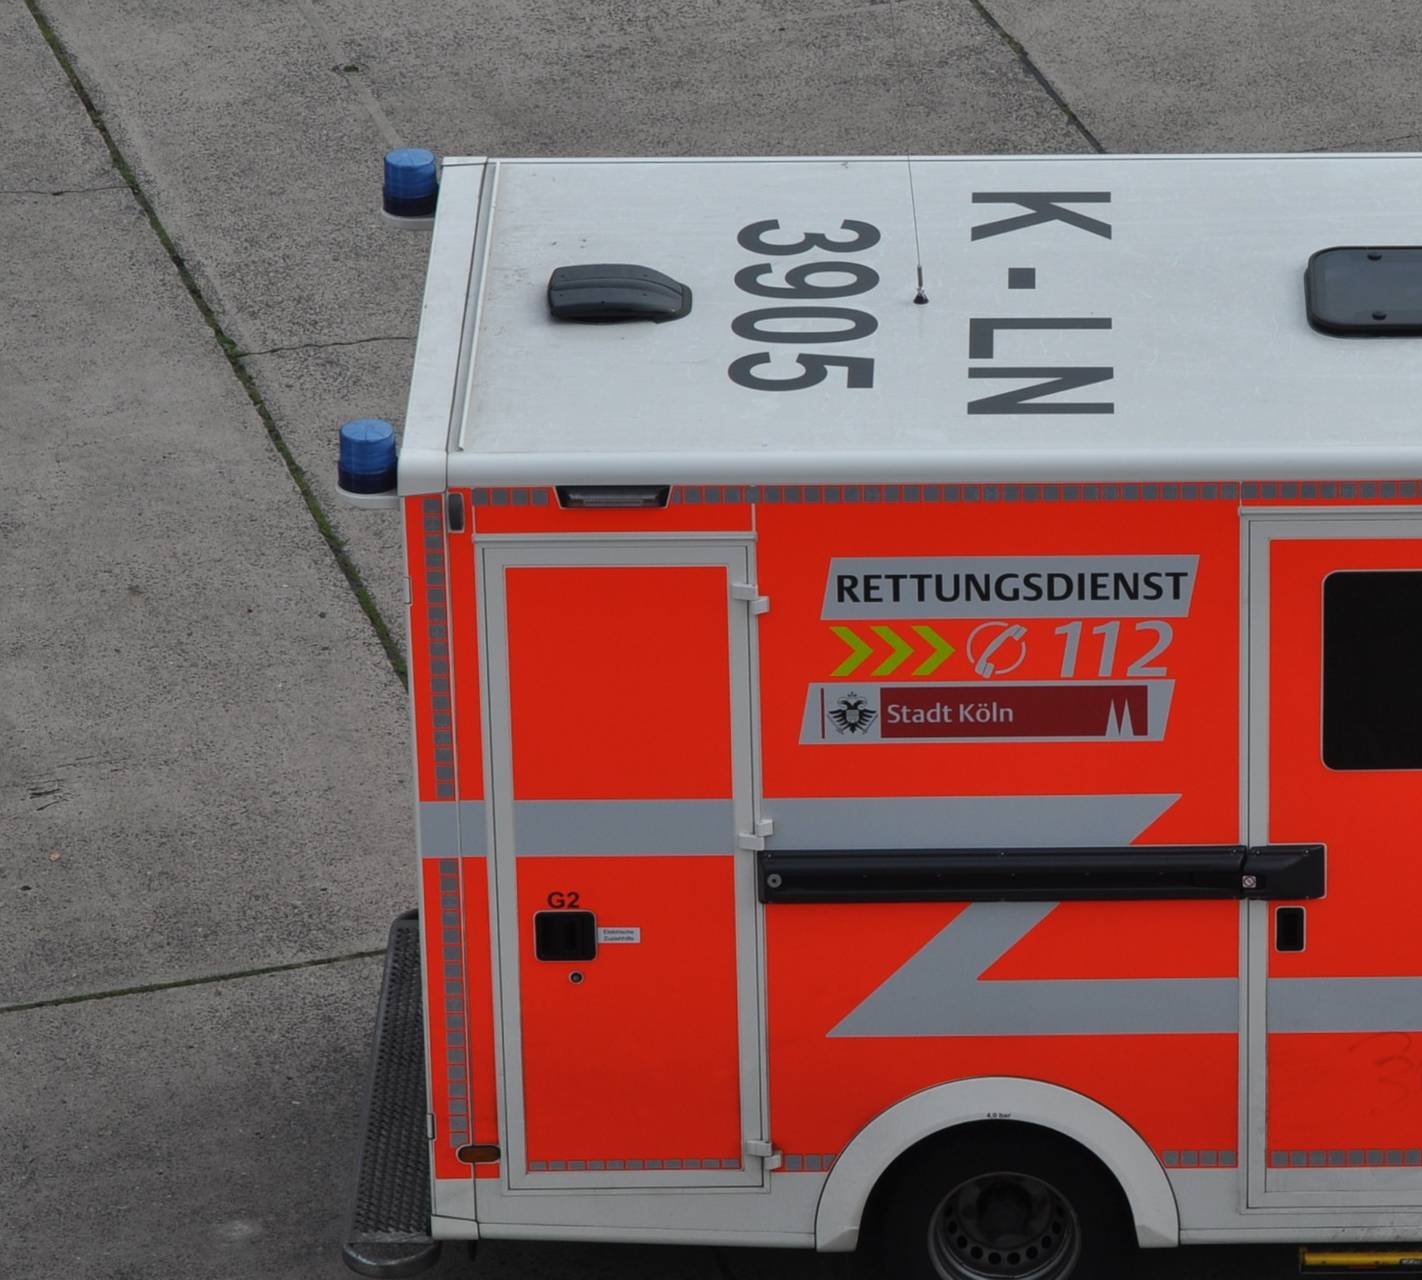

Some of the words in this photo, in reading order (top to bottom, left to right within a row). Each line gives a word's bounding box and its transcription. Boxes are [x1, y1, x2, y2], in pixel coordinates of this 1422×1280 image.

[727, 218, 881, 392] 3905
[836, 571, 1189, 603] RETTUNGSDIENST
[1054, 620, 1174, 678] 112
[886, 703, 953, 724] Stadt
[959, 701, 1014, 723] Köln
[546, 891, 581, 909] G2
